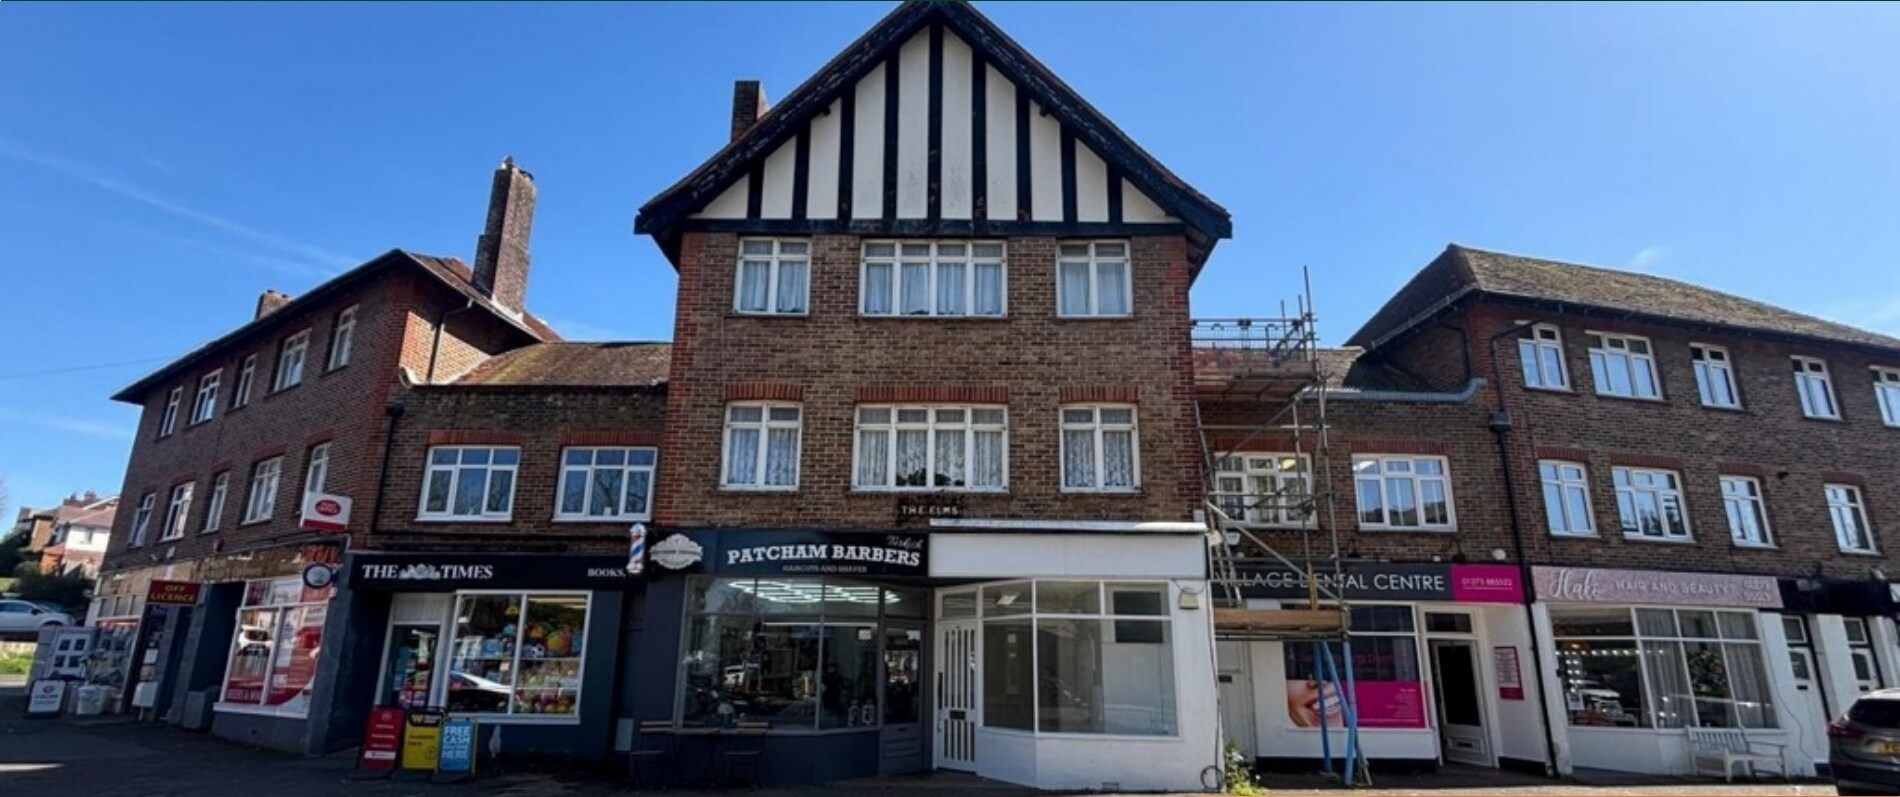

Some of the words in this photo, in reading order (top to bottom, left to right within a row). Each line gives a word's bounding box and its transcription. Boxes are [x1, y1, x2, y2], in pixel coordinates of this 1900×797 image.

[901, 505, 924, 515] THE
[929, 505, 959, 516] ELMS
[726, 544, 827, 564] PATCHAM
[831, 544, 920, 567] BARBERS
[362, 564, 398, 579] THE
[440, 564, 493, 579] TIMES
[821, 565, 837, 573] AND
[1374, 573, 1445, 591] CENTRE
[1614, 579, 1646, 591] HAIR
[1652, 580, 1676, 591] AND
[1680, 581, 1726, 594] BEAUTY
[164, 584, 186, 592] OFF
[150, 592, 195, 602] LICENCE
[444, 726, 470, 735] FREE
[443, 735, 470, 744] CASH
